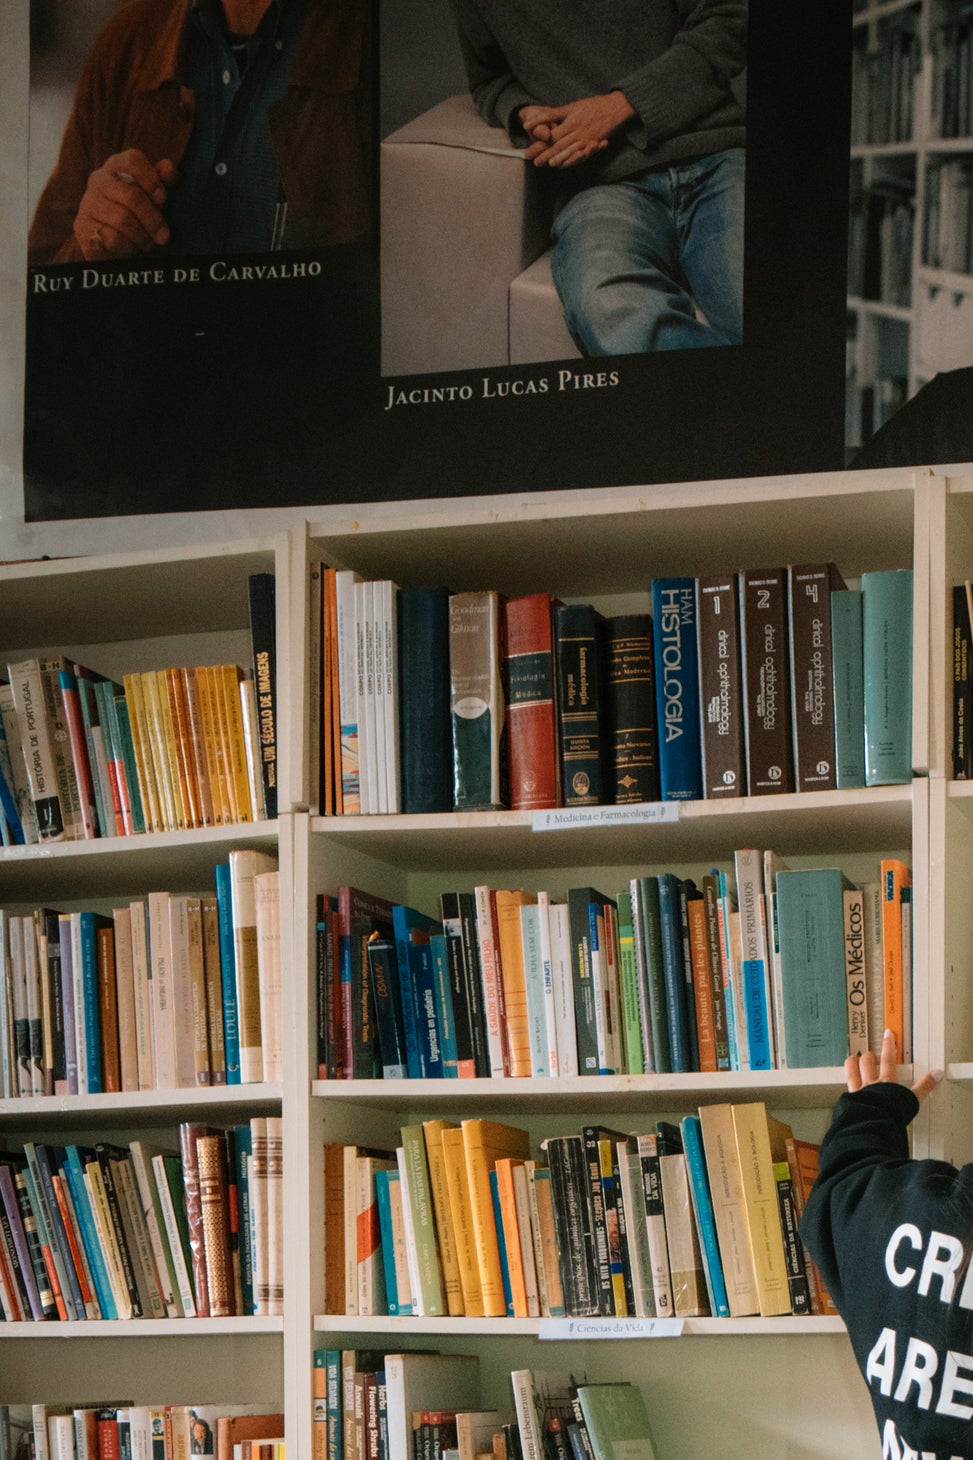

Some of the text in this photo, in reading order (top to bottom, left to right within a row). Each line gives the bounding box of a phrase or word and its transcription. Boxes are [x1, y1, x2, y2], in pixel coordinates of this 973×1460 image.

[33, 261, 322, 294] RUY DUARTE DE CARVALHO
[384, 368, 620, 411] JACINTO LUCAS PIRES
[680, 588, 693, 625] HAM
[713, 596, 721, 615] 1
[757, 590, 771, 609] 2
[661, 588, 684, 743] HISTOLOGIA
[257, 651, 277, 762] UM SÉCULO DE IMAGENS
[554, 813, 592, 824] Medicina
[600, 808, 656, 821] Farmacologia
[481, 939, 492, 964] FILHO
[743, 881, 764, 1044] MANUAL DE CUIDADOS PRIMÁRIOS
[846, 903, 865, 1006] Os Médicos
[485, 966, 495, 984] MEU
[543, 960, 551, 988] ENFARTE
[692, 911, 711, 1042] La beauté par les plantes
[487, 985, 496, 999] DO
[426, 1019, 434, 1029] en
[487, 1002, 499, 1029] SAÚDE
[850, 1010, 860, 1034] Henry
[858, 1010, 867, 1039] Denker
[424, 1030, 440, 1062] Urgencias
[576, 1323, 644, 1334] Ciências da Vida
[354, 1384, 363, 1419] Annuals
[378, 1384, 388, 1410] Herbs
[571, 1397, 583, 1422] Trees
[367, 1385, 378, 1458] Flowering Shrubs
